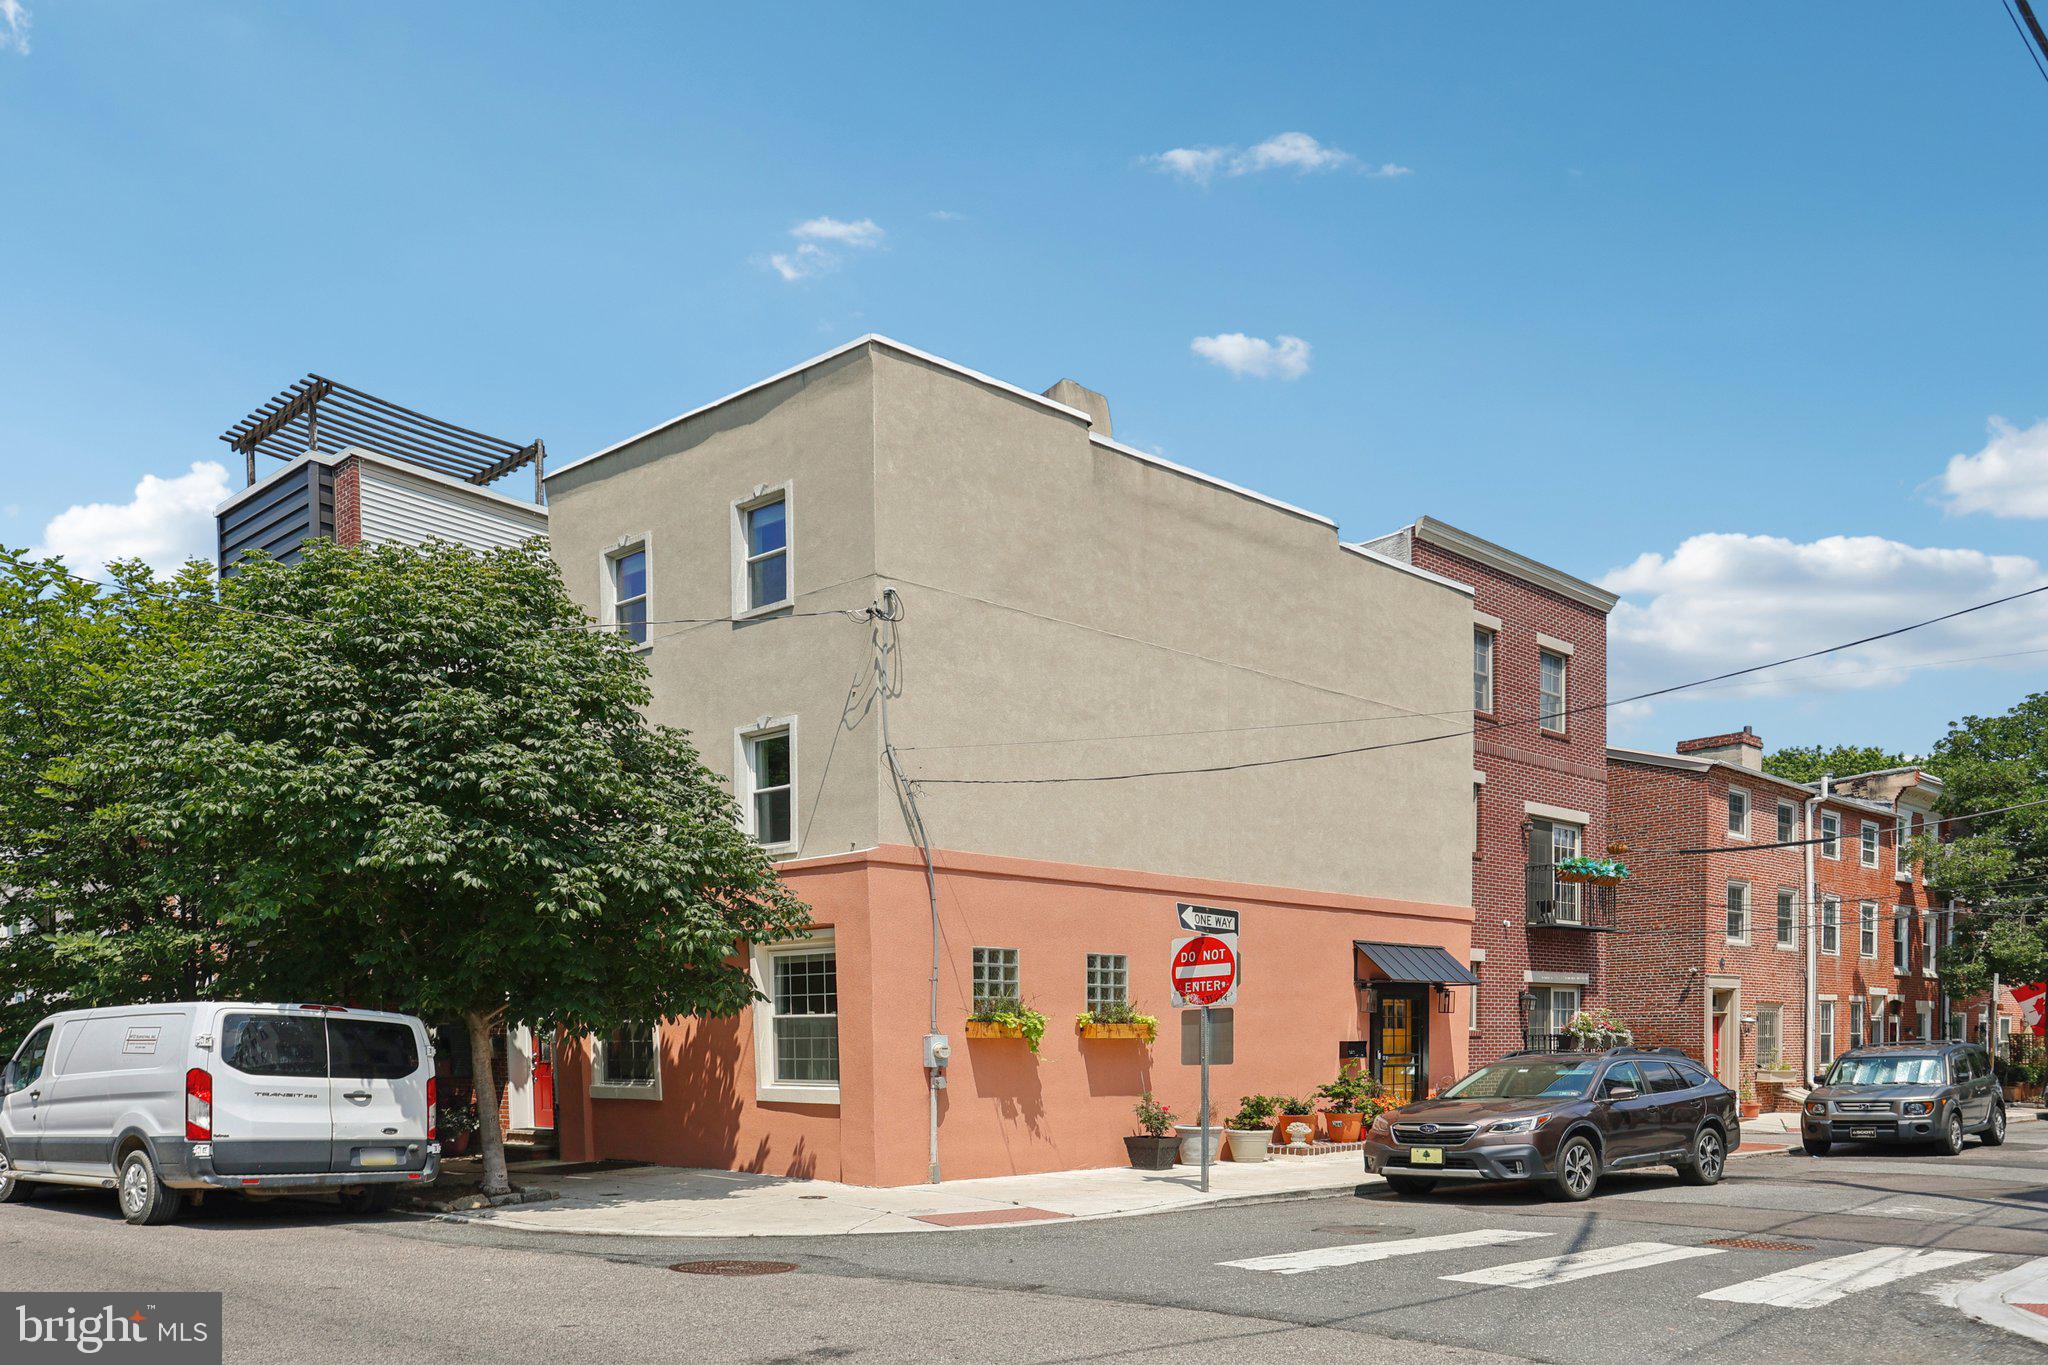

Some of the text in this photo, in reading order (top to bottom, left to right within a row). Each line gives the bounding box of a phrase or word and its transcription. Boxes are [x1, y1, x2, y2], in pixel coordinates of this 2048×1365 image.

[1194, 913, 1233, 929] ONE WAY
[1181, 948, 1226, 963] DO NOT
[1185, 980, 1221, 992] ENTER
